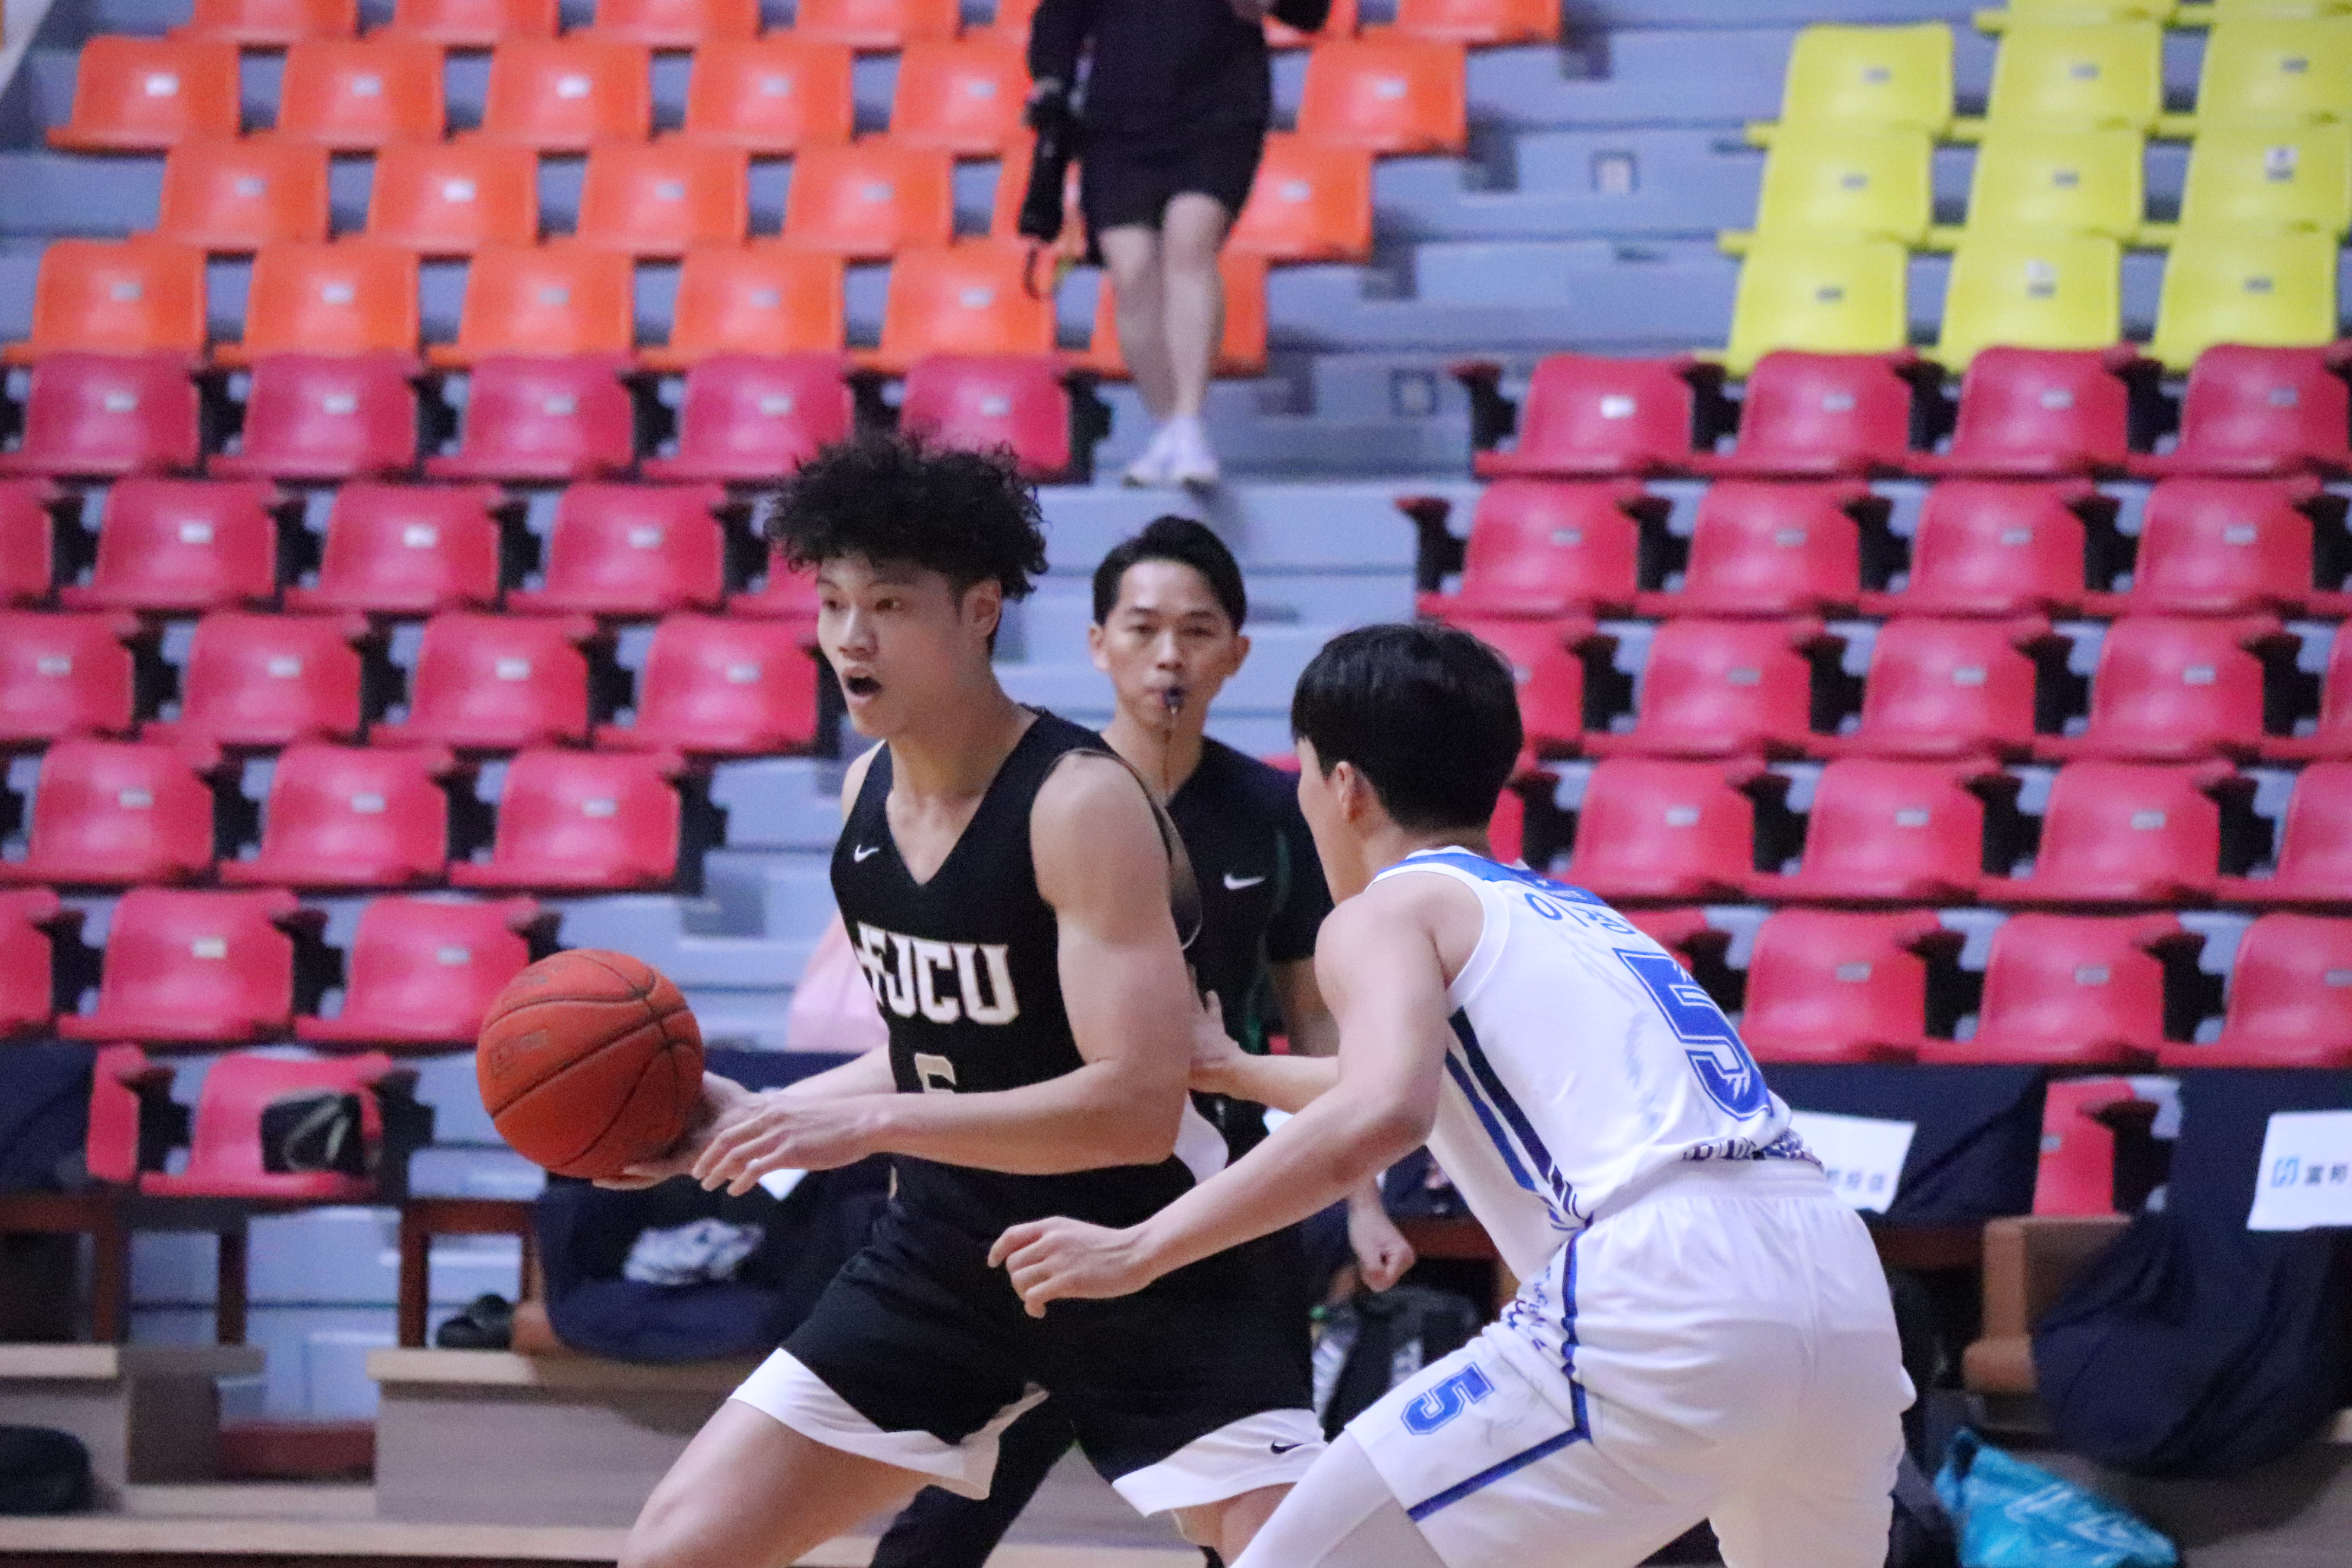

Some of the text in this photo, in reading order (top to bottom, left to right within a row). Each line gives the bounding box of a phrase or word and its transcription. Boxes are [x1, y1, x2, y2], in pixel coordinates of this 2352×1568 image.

[855, 922, 1020, 1025] FJCU
[1612, 948, 1773, 1122] 5
[1400, 1361, 1495, 1436] 5
